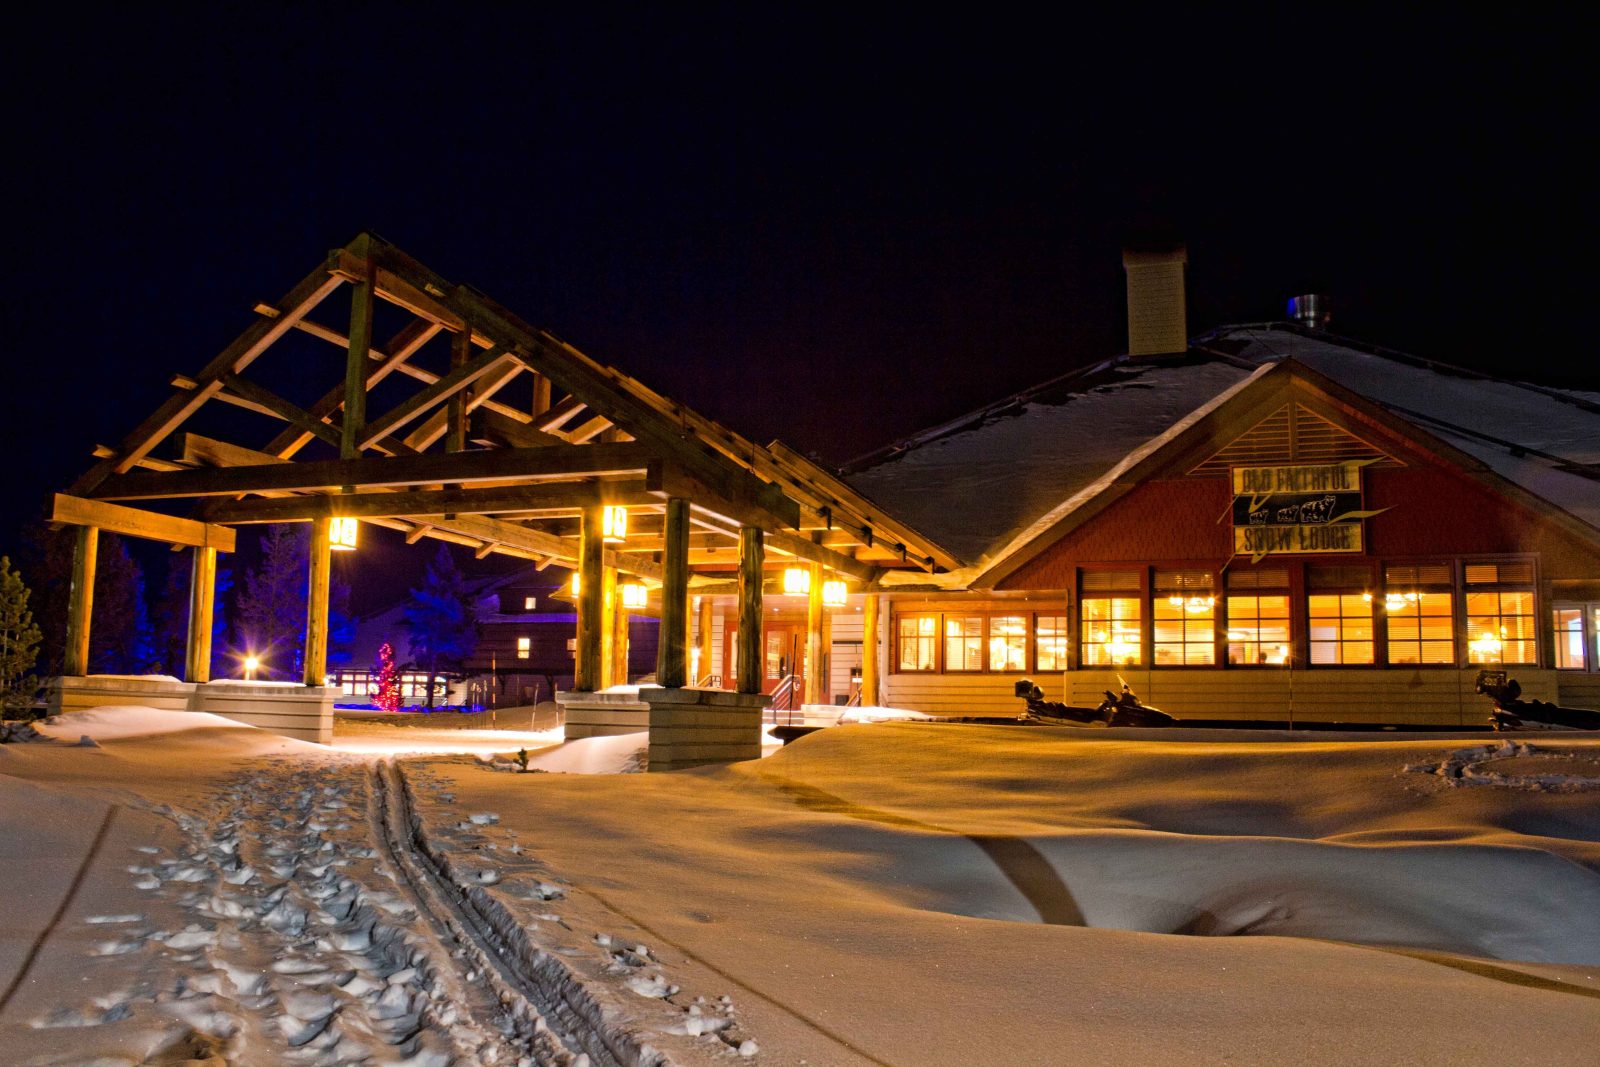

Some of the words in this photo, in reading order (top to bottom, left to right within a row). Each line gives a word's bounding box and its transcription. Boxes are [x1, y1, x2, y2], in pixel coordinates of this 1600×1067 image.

[1243, 468, 1272, 492] OLD
[1277, 466, 1350, 491] FAITHFUL
[1244, 527, 1291, 551] SNOW
[1298, 525, 1351, 550] LODGE
